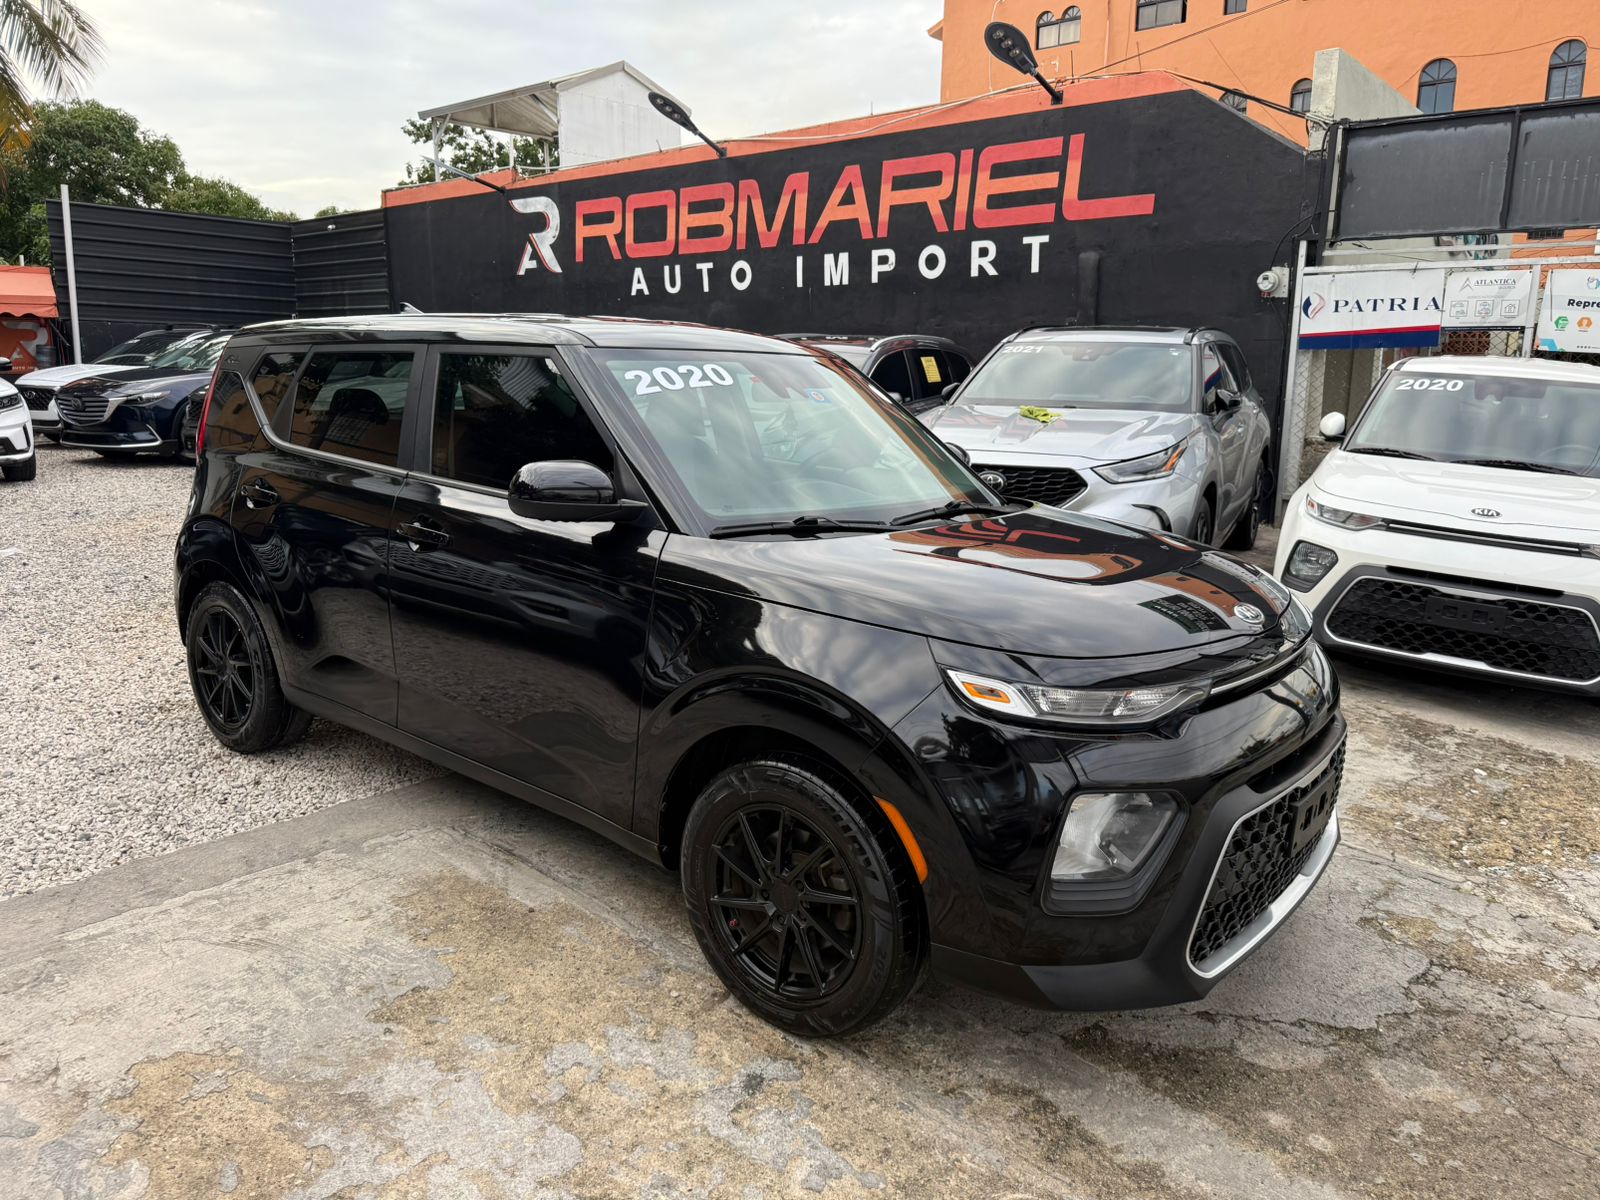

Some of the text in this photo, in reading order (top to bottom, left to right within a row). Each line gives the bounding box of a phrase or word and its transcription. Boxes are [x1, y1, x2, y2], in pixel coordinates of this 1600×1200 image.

[575, 133, 1155, 262] ROBMARIEL
[630, 235, 1050, 296] AUTO IMPORT
[1333, 296, 1441, 313] PATRIA
[1001, 345, 1044, 353] 2021
[624, 363, 734, 396] 2020
[1396, 378, 1464, 392] 2020
[1474, 508, 1498, 517] KIA
